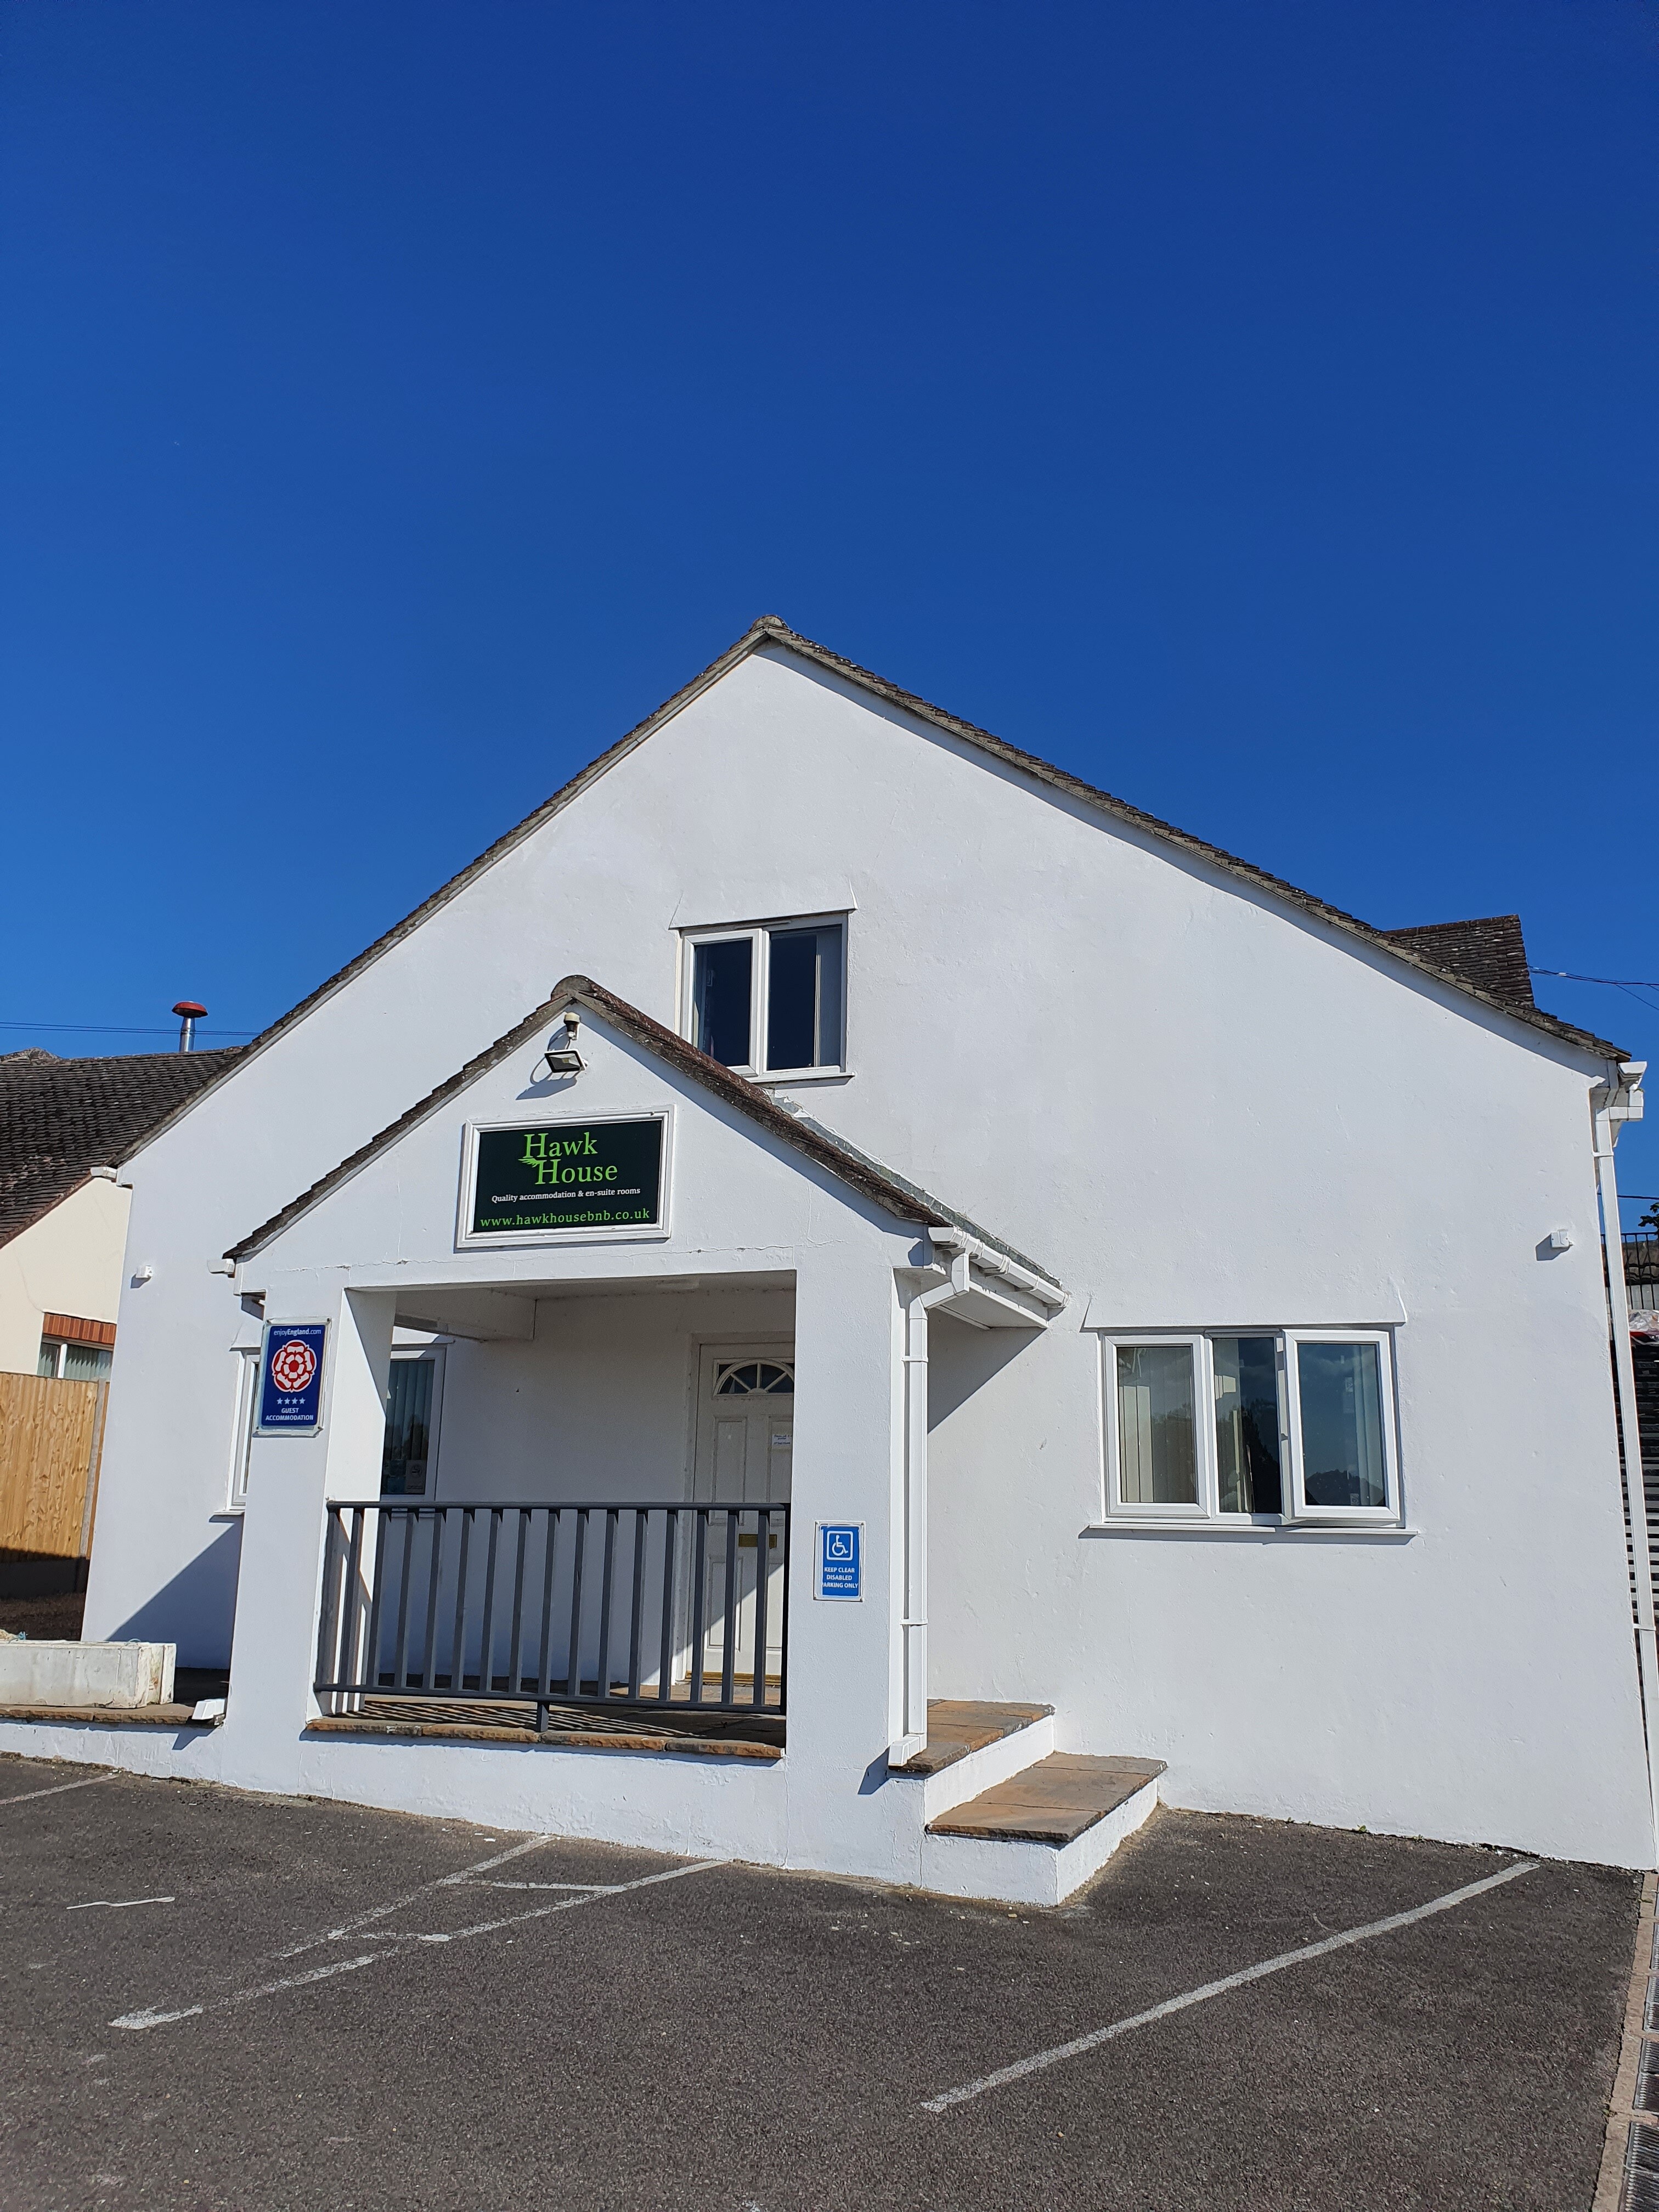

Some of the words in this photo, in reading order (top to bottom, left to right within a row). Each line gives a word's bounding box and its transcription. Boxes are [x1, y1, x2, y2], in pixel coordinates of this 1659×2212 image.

[522, 1132, 598, 1158] Hawk
[534, 1159, 618, 1184] House
[492, 1194, 518, 1204] Quality
[519, 1191, 576, 1200] accommodation
[480, 1208, 650, 1227] www.hawkhousebnb.co.uk
[274, 1328, 321, 1336] enjoyEngland.com
